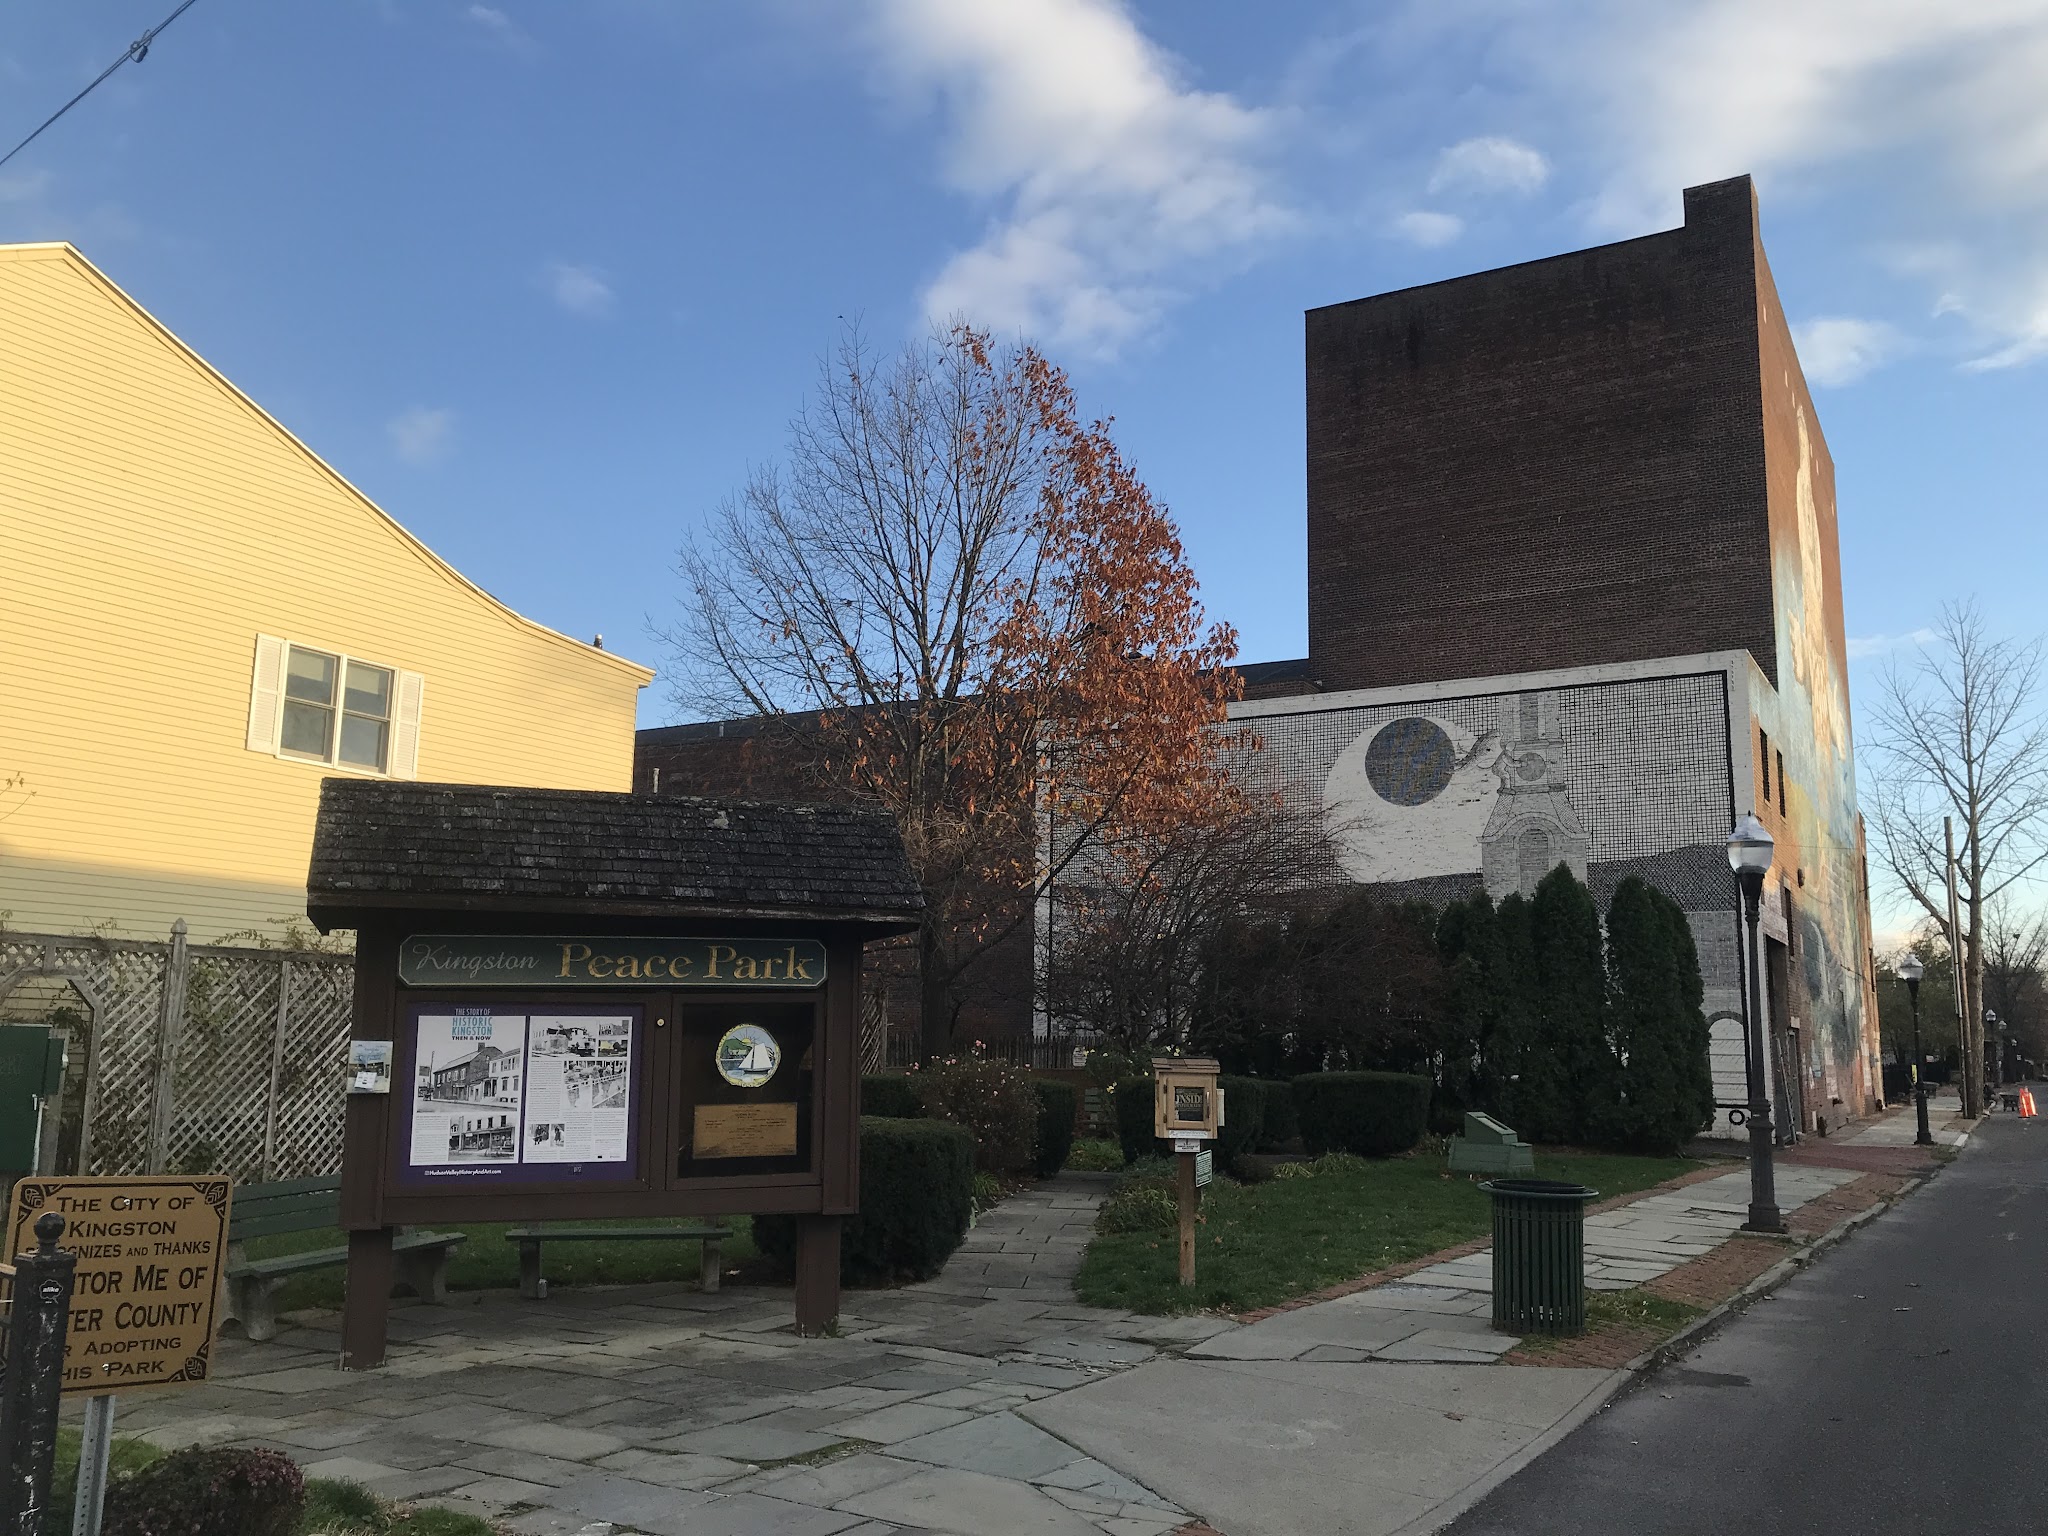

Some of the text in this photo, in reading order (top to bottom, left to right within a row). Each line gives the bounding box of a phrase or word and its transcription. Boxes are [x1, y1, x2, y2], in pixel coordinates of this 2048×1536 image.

[412, 943, 814, 981] Kingston Peace Park
[455, 1008, 491, 1016] THE STORY OF
[452, 1017, 493, 1026] HISTORIC
[452, 1027, 493, 1036] KINGSTON
[57, 1195, 195, 1213] THE CITY OF
[69, 1221, 177, 1238] KINGSTON
[126, 1247, 149, 1257] AND
[153, 1241, 211, 1256] THANKS
[133, 1265, 169, 1292] ME
[178, 1266, 209, 1290] OF
[115, 1302, 204, 1330] COUNTY
[83, 1337, 182, 1356] ADOPTING
[105, 1360, 165, 1377] PARK
